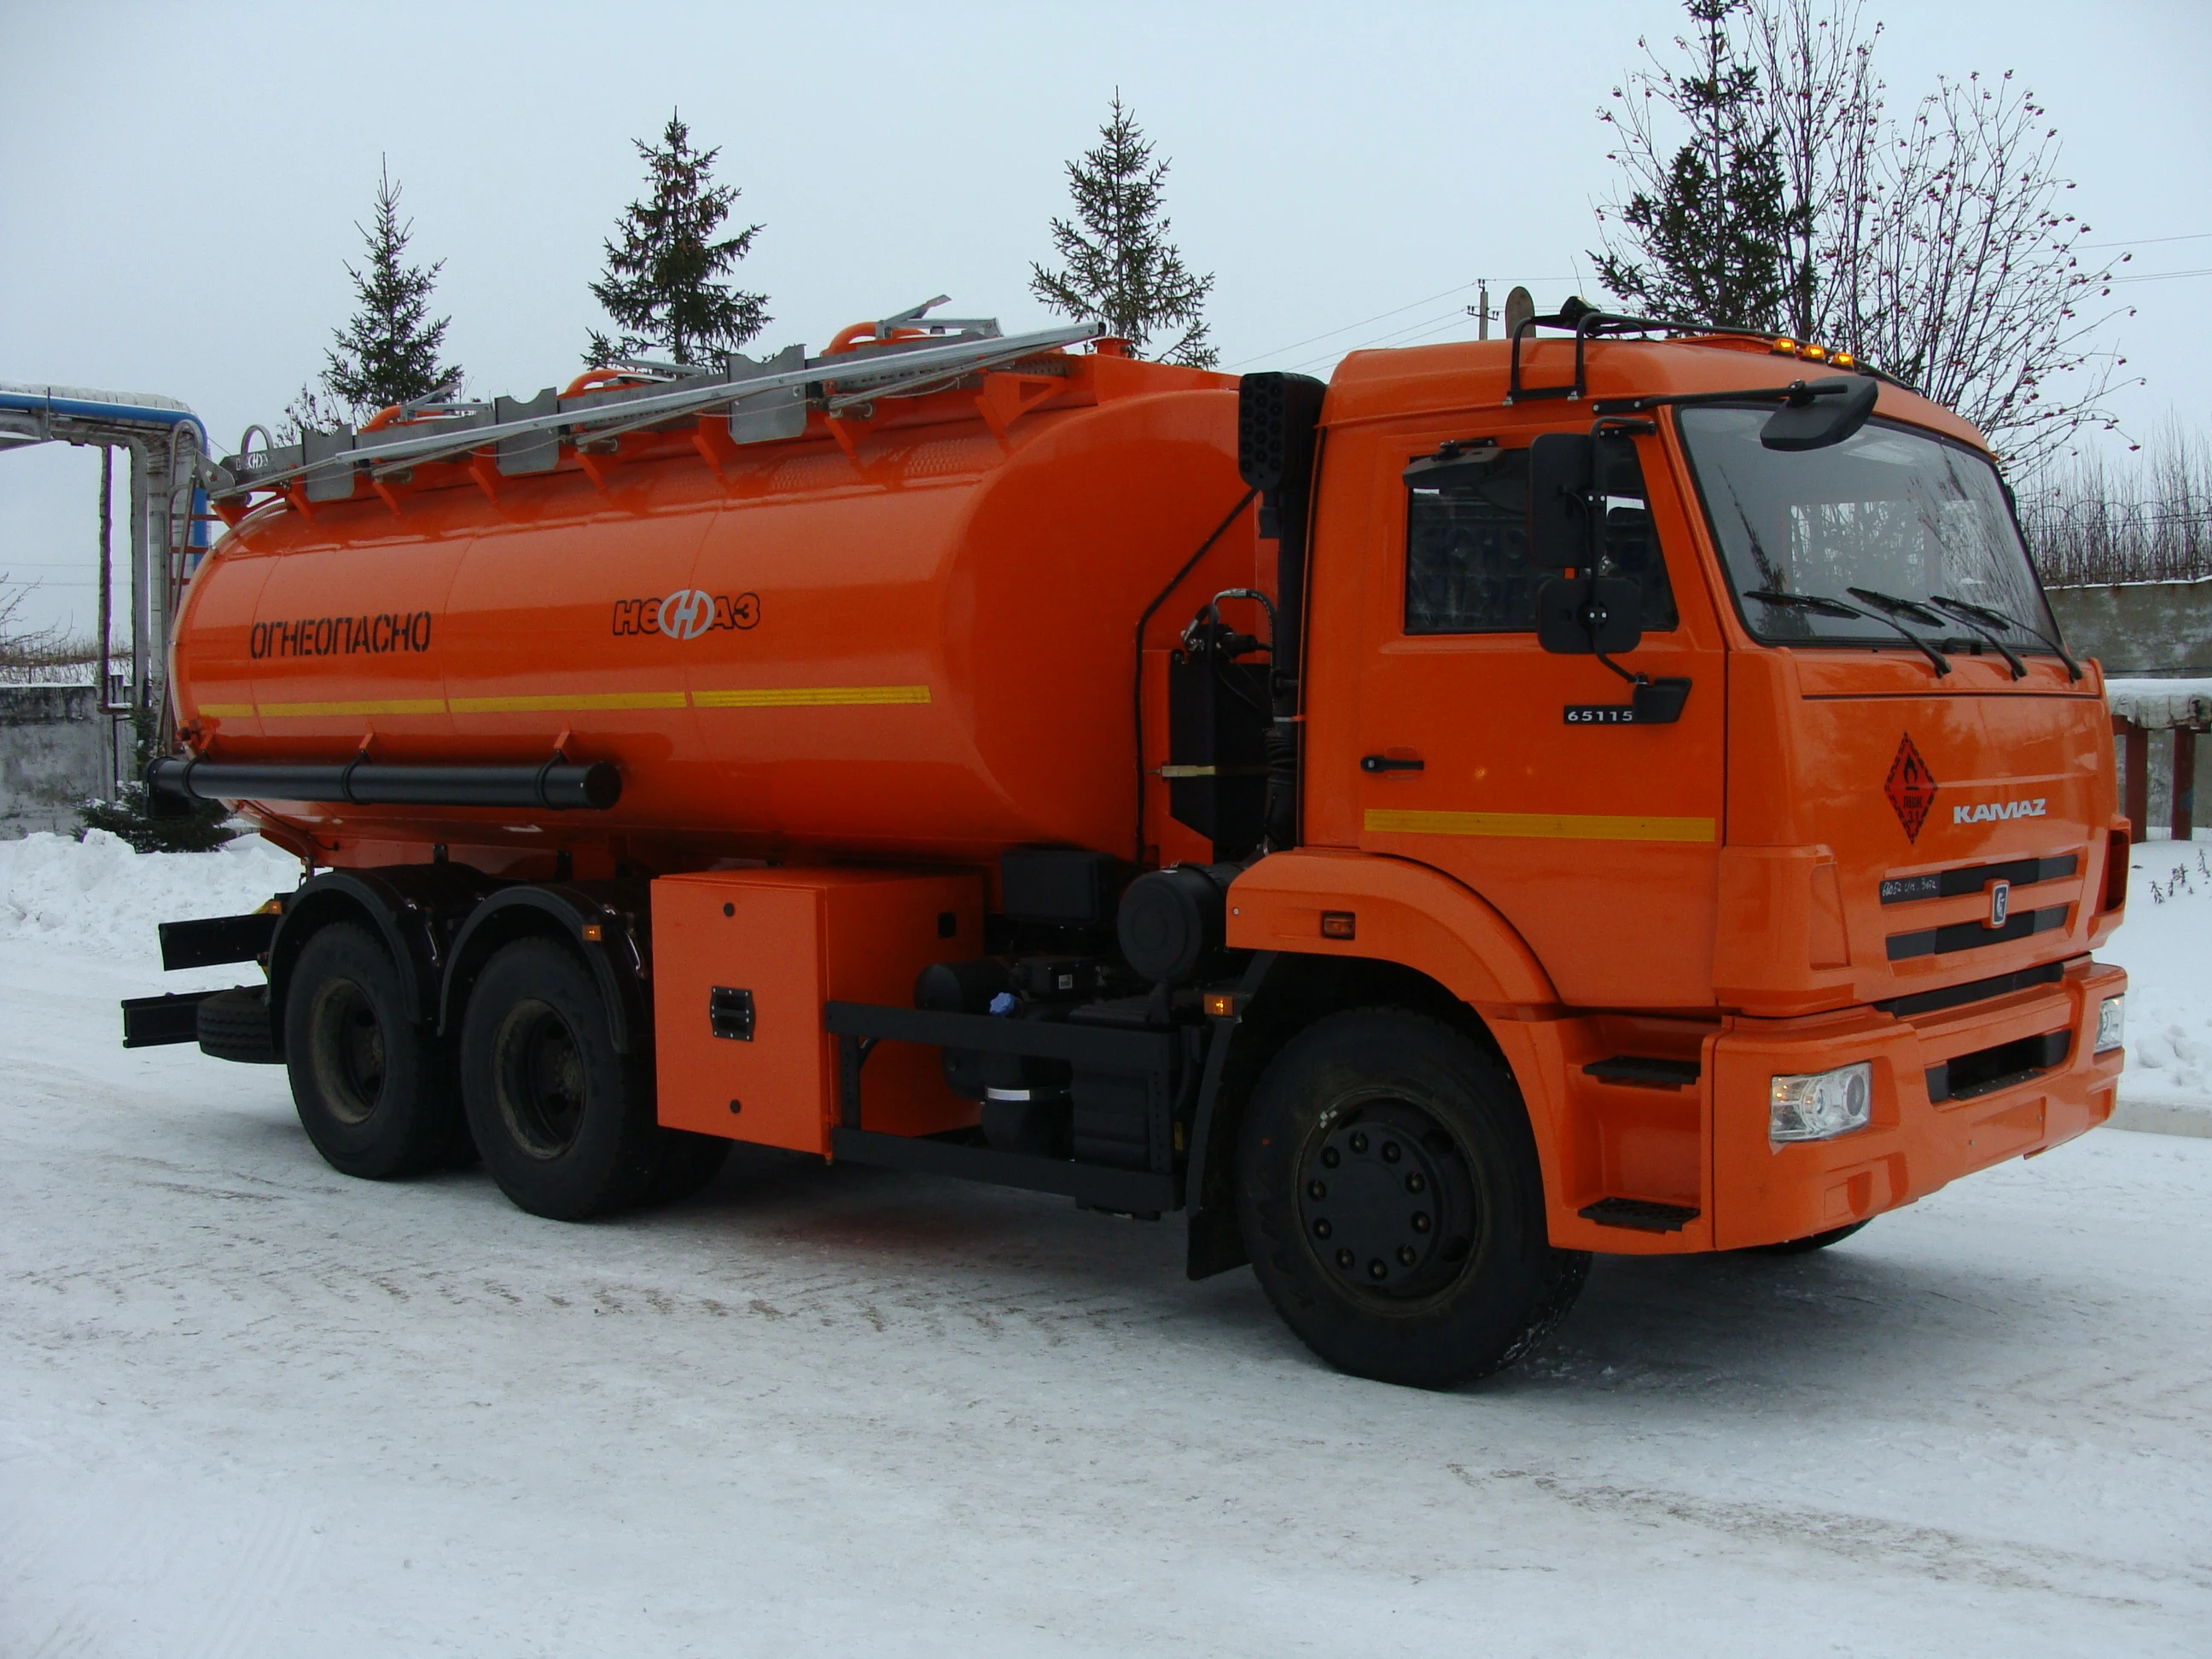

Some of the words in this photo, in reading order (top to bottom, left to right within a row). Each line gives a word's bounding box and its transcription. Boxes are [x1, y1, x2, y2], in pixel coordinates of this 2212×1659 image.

[250, 611, 431, 659] ОГНЕОПАСНО
[1567, 711, 1633, 722] 65115
[1953, 798, 2046, 824] KAMAZ
